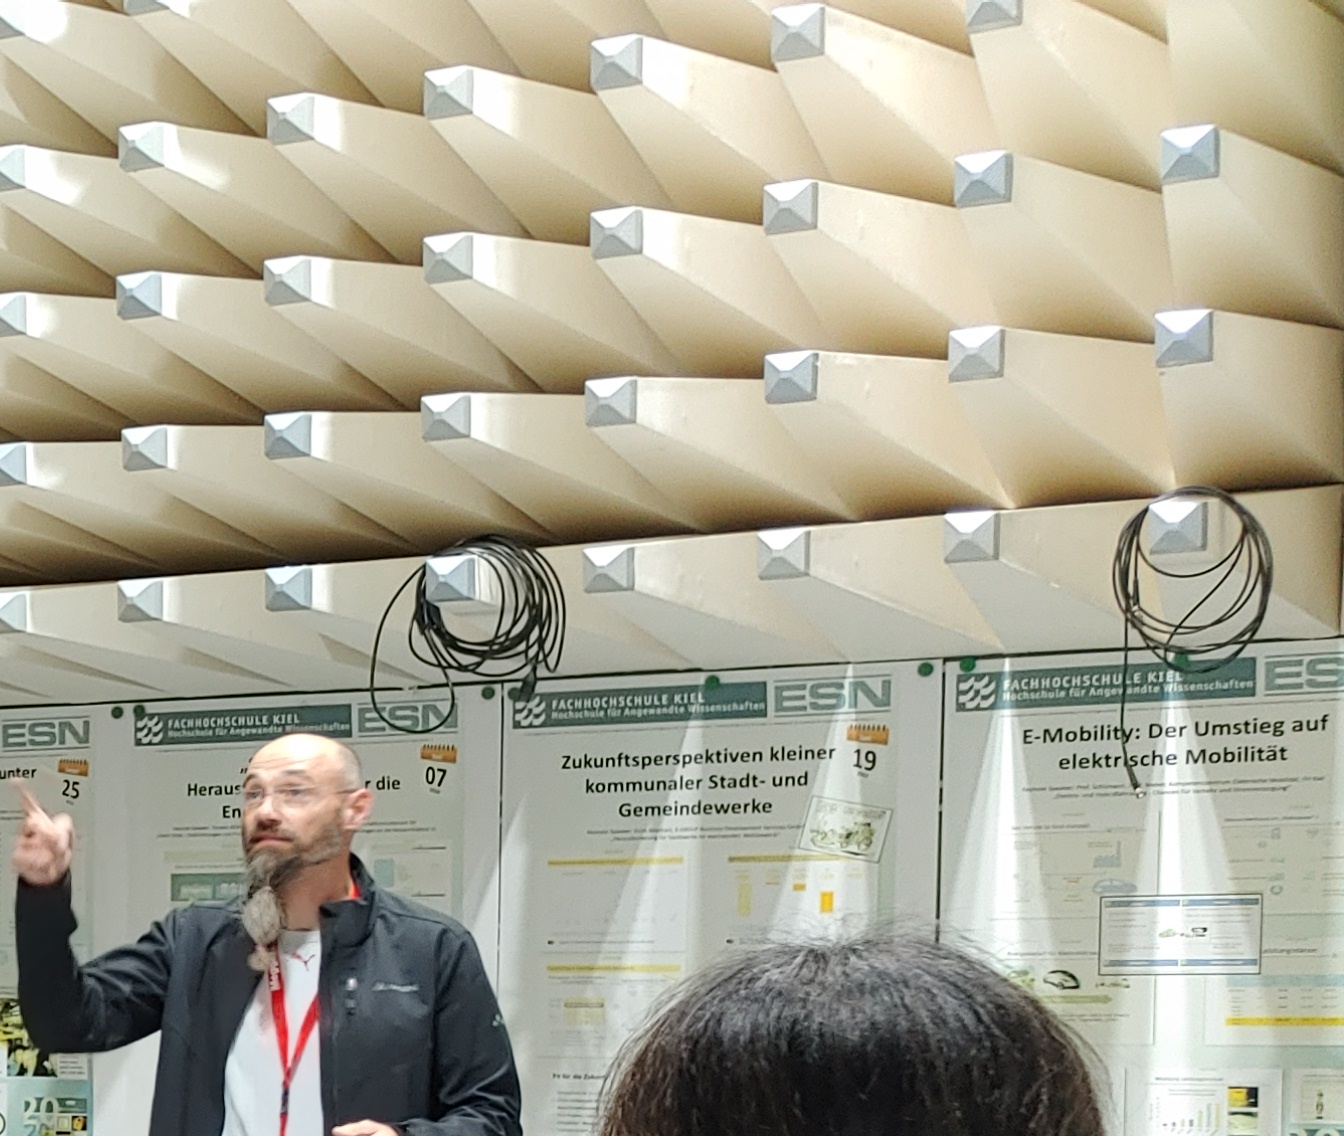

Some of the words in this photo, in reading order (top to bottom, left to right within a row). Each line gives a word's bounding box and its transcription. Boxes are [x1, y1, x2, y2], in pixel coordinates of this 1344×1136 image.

[1003, 672, 1142, 691] FACHHOCHSCHULE
[1148, 670, 1183, 683] KIEL
[1265, 657, 1344, 691] ES
[552, 693, 668, 711] FACHHOCHSCHULE
[674, 692, 705, 705] KIEL
[774, 680, 892, 713] ESN
[1003, 688, 1065, 701] Hochschule
[1069, 687, 1086, 698] für
[1164, 679, 1254, 694] Wissenschaften
[168, 714, 269, 730] FACHHOCHSCHULE
[273, 713, 300, 724] KIEL
[358, 703, 458, 734] ESN
[551, 709, 605, 720] Hochschule
[607, 707, 621, 719] für
[624, 705, 685, 718] Angewandte
[688, 701, 765, 714] Wissenschaften
[2, 719, 90, 748] ESN
[1023, 724, 1142, 745] E-Mobility:
[1148, 721, 1187, 739] Der
[1195, 716, 1285, 738] Umstieg
[1291, 713, 1329, 732] auf
[562, 748, 764, 772] Zukunftsperspektiven
[769, 744, 837, 763] kleiner
[853, 748, 877, 772] 19
[1059, 749, 1178, 771] elektrische
[1185, 745, 1289, 766] Mobilität
[187, 783, 241, 798] Heraus
[375, 776, 401, 791] die
[425, 766, 448, 787] 07
[585, 774, 703, 795] kommunaler
[707, 772, 766, 792] Stadt-
[772, 770, 809, 788] und
[62, 779, 80, 799] 25
[619, 799, 774, 819] Gemeindewerke
